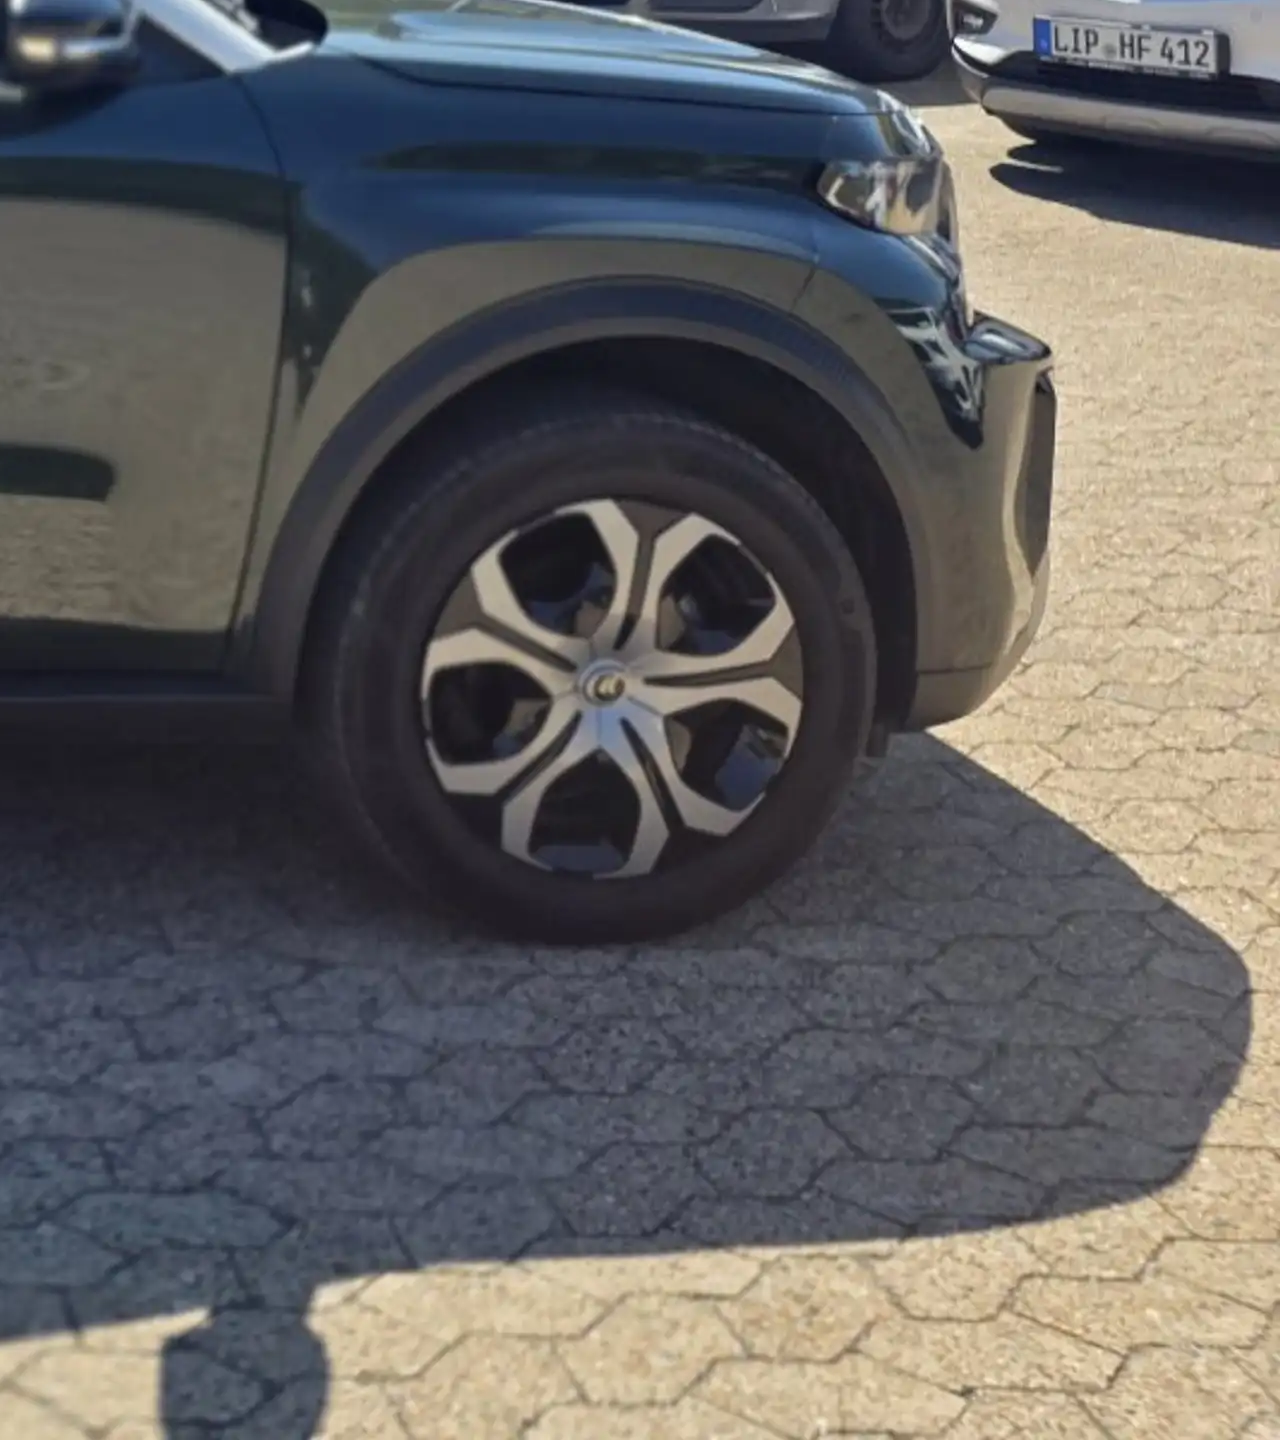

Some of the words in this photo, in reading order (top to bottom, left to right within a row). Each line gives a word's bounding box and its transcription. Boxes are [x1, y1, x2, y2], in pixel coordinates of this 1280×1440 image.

[1053, 25, 1100, 55] LIP
[1119, 32, 1153, 60] HF
[1160, 38, 1210, 68] 412
